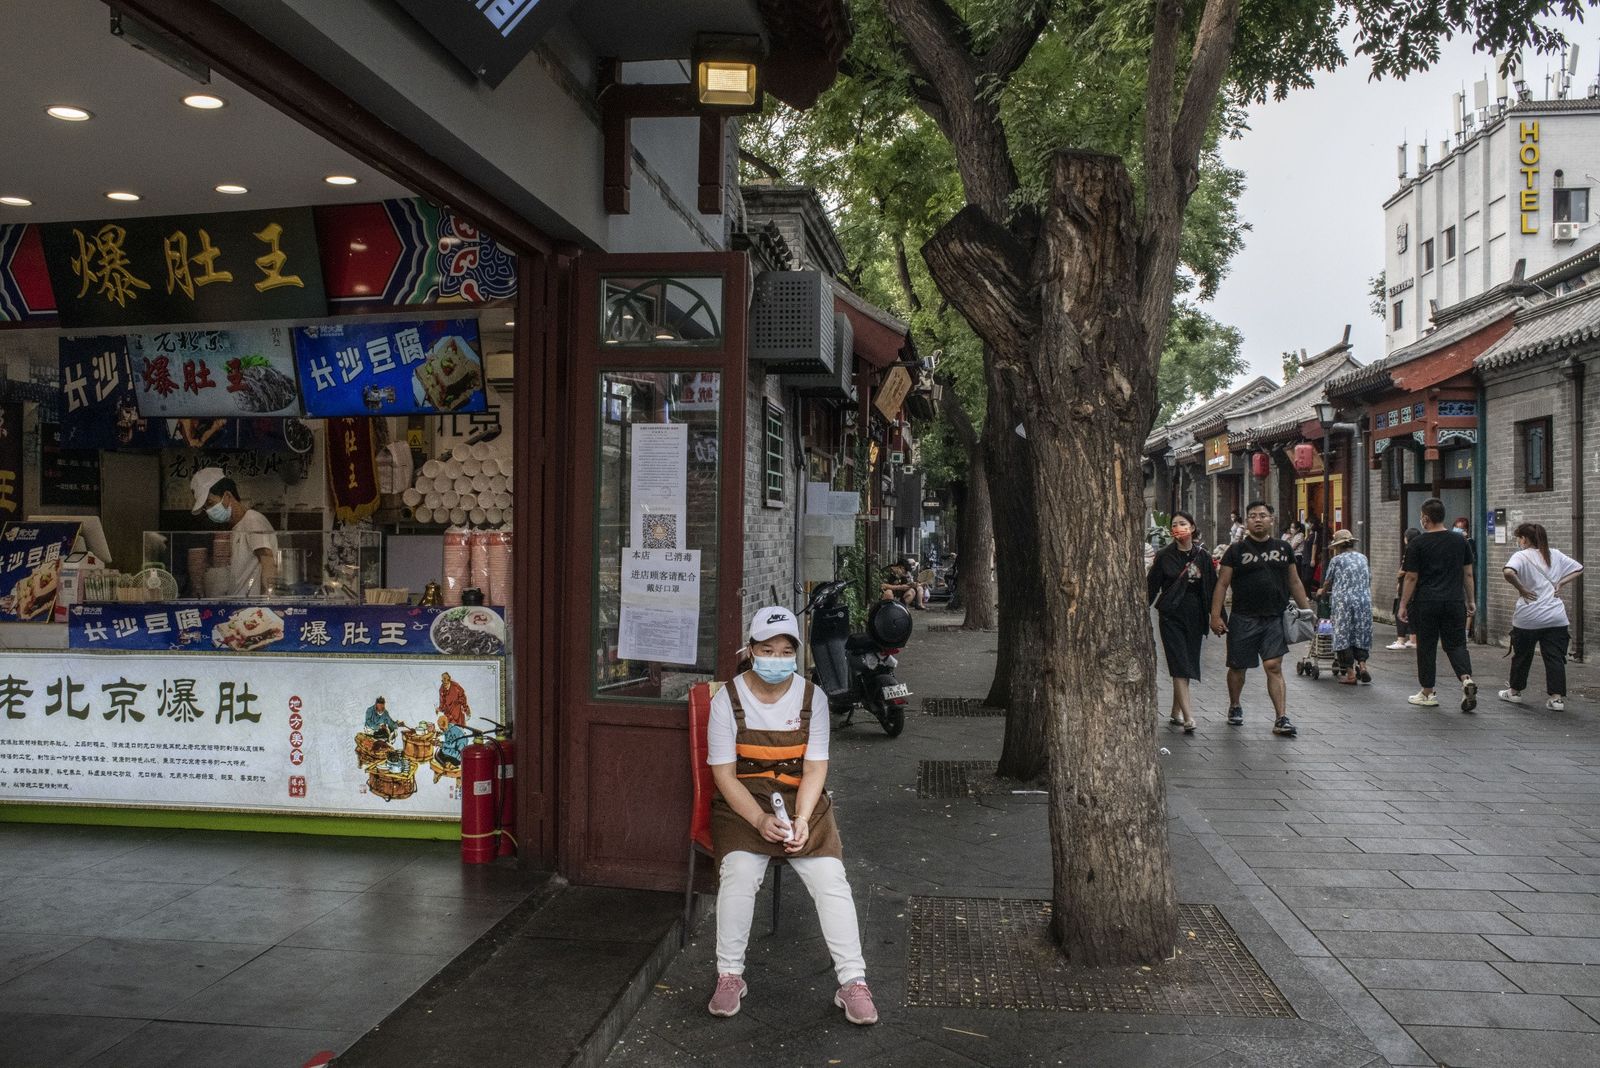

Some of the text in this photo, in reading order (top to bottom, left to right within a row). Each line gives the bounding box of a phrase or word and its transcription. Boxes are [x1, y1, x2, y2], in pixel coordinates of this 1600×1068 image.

[1520, 119, 1540, 234] HOTEL
[71, 223, 304, 308] 爆肚王
[64, 343, 135, 413] 长沙
[142, 354, 250, 398] 爆肚王
[311, 327, 426, 392] 长沙豆腐
[631, 570, 697, 582] 进店顾客请配合
[632, 550, 692, 562] 本店 已消毒
[646, 583, 680, 593] 戴好口罩
[84, 608, 202, 642] 长沙豆腐
[300, 620, 408, 647] 爆肚王
[0, 674, 262, 725] 老北京爆肚
[289, 695, 304, 766] 地方美食
